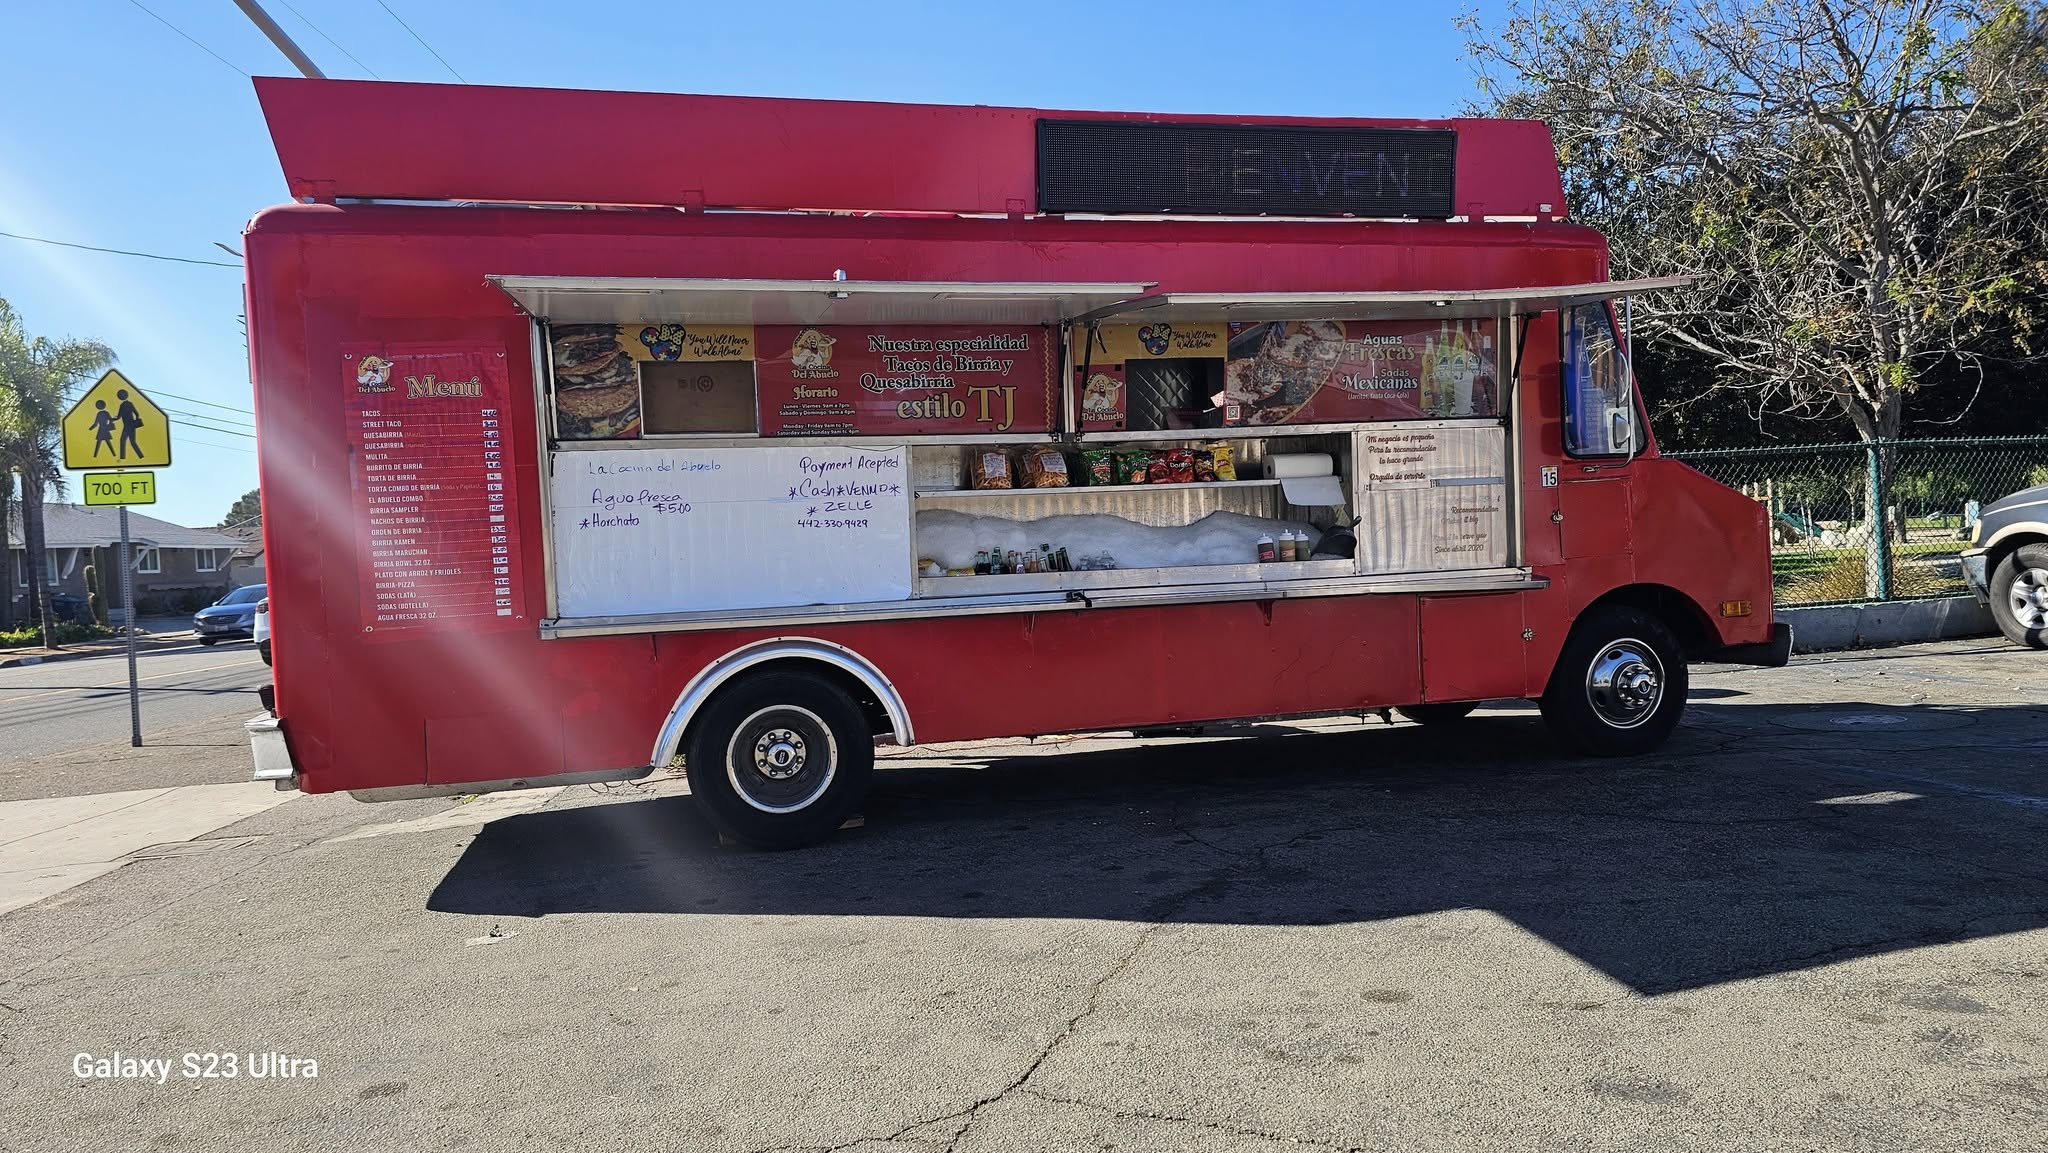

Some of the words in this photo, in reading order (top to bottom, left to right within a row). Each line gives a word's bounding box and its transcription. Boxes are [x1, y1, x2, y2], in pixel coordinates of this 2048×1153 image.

[868, 335, 933, 352] Nuestra
[935, 334, 1029, 356] especialidad
[1364, 334, 1402, 348] Aguas
[1345, 343, 1415, 360] Frescas
[883, 355, 930, 373] Tacos
[933, 356, 952, 372] de
[954, 355, 1000, 372] Birria
[1000, 360, 1013, 376] y
[1381, 368, 1410, 377] Sodas
[808, 370, 838, 378] Abuelo
[1341, 372, 1418, 390] Mexicanas
[404, 375, 482, 398] Menú
[860, 373, 955, 393] Quesabirria
[793, 384, 838, 400] Horario
[897, 392, 966, 418] estilo
[967, 385, 1017, 432] TJ
[1082, 412, 1096, 421] Del
[1096, 411, 1124, 421] Abuelo
[1378, 435, 1401, 444] negocio
[657, 459, 675, 472] del
[681, 459, 721, 472] Abuelo
[800, 456, 852, 478] Payment
[858, 455, 899, 474] Acepted
[1544, 472, 1556, 486] 15
[92, 482, 122, 496] 700
[131, 482, 148, 494] FT
[824, 500, 873, 512] ZELLE
